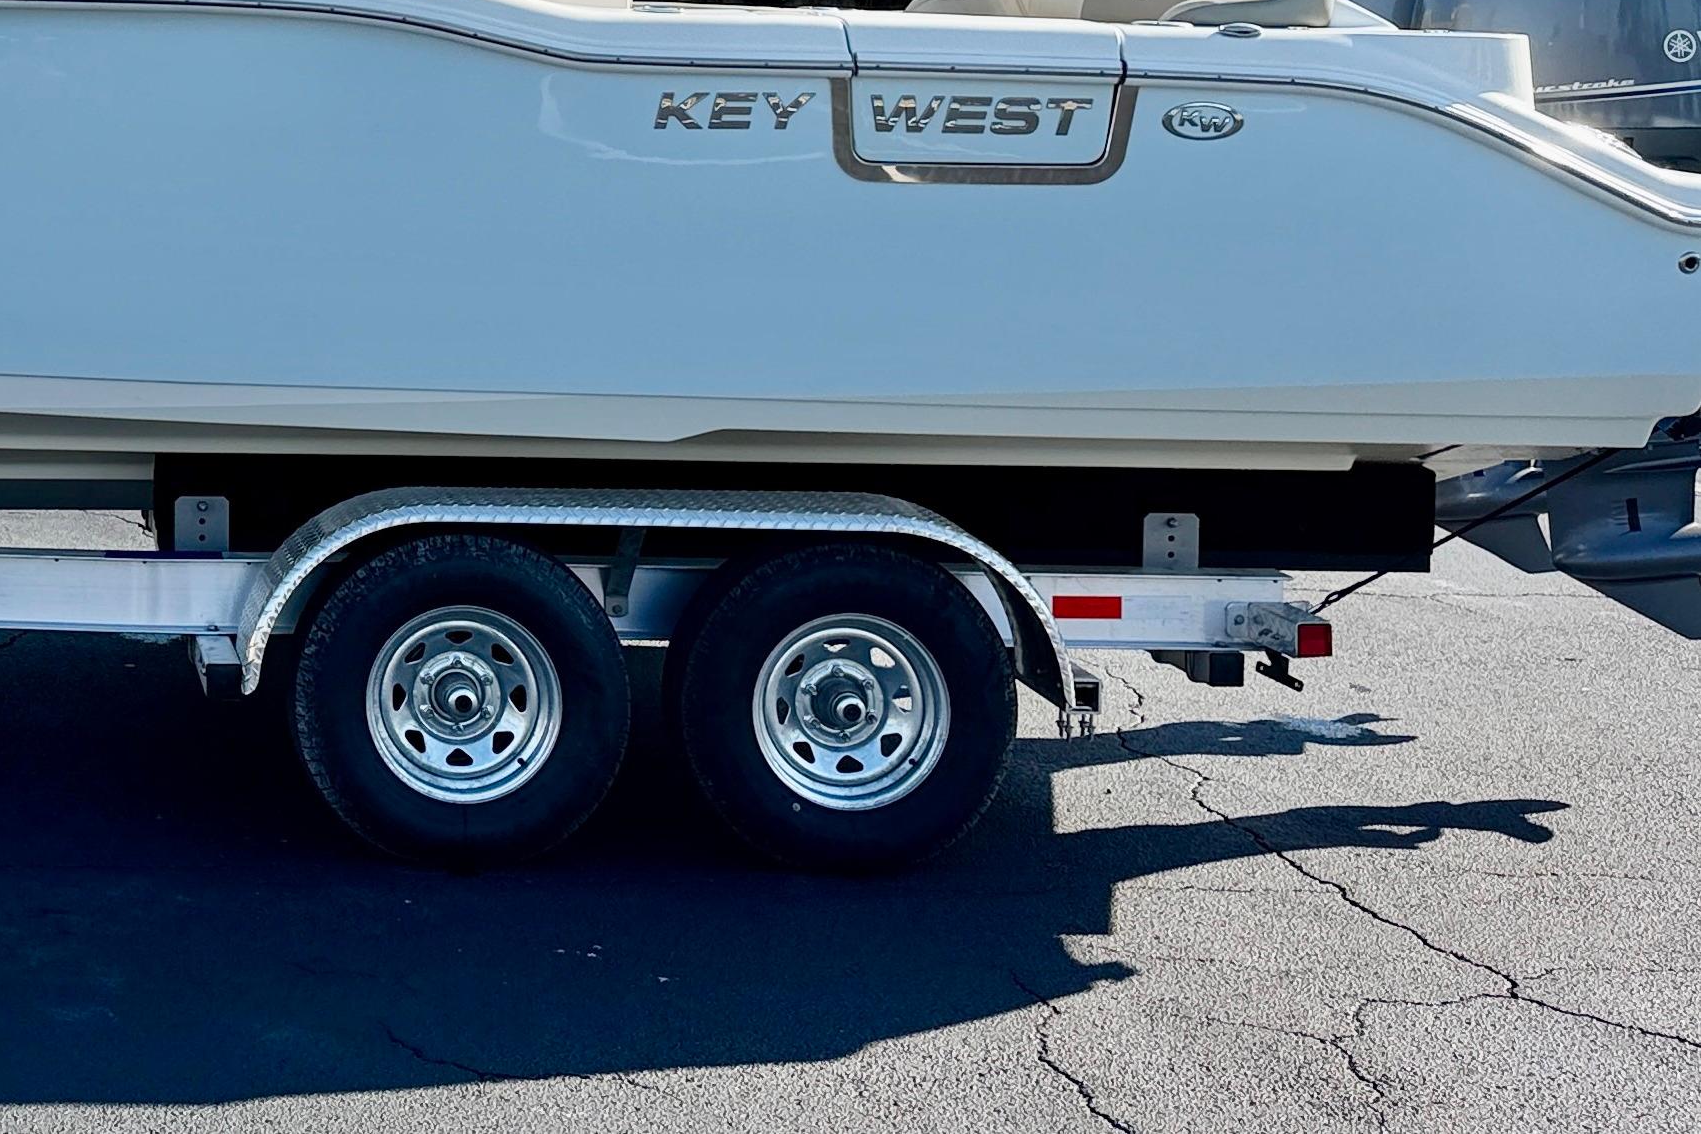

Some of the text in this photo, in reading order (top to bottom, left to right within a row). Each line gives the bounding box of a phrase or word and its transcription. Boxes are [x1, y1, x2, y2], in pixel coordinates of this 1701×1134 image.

[653, 91, 1094, 136] KEY WEST
[1178, 107, 1230, 133] KW
